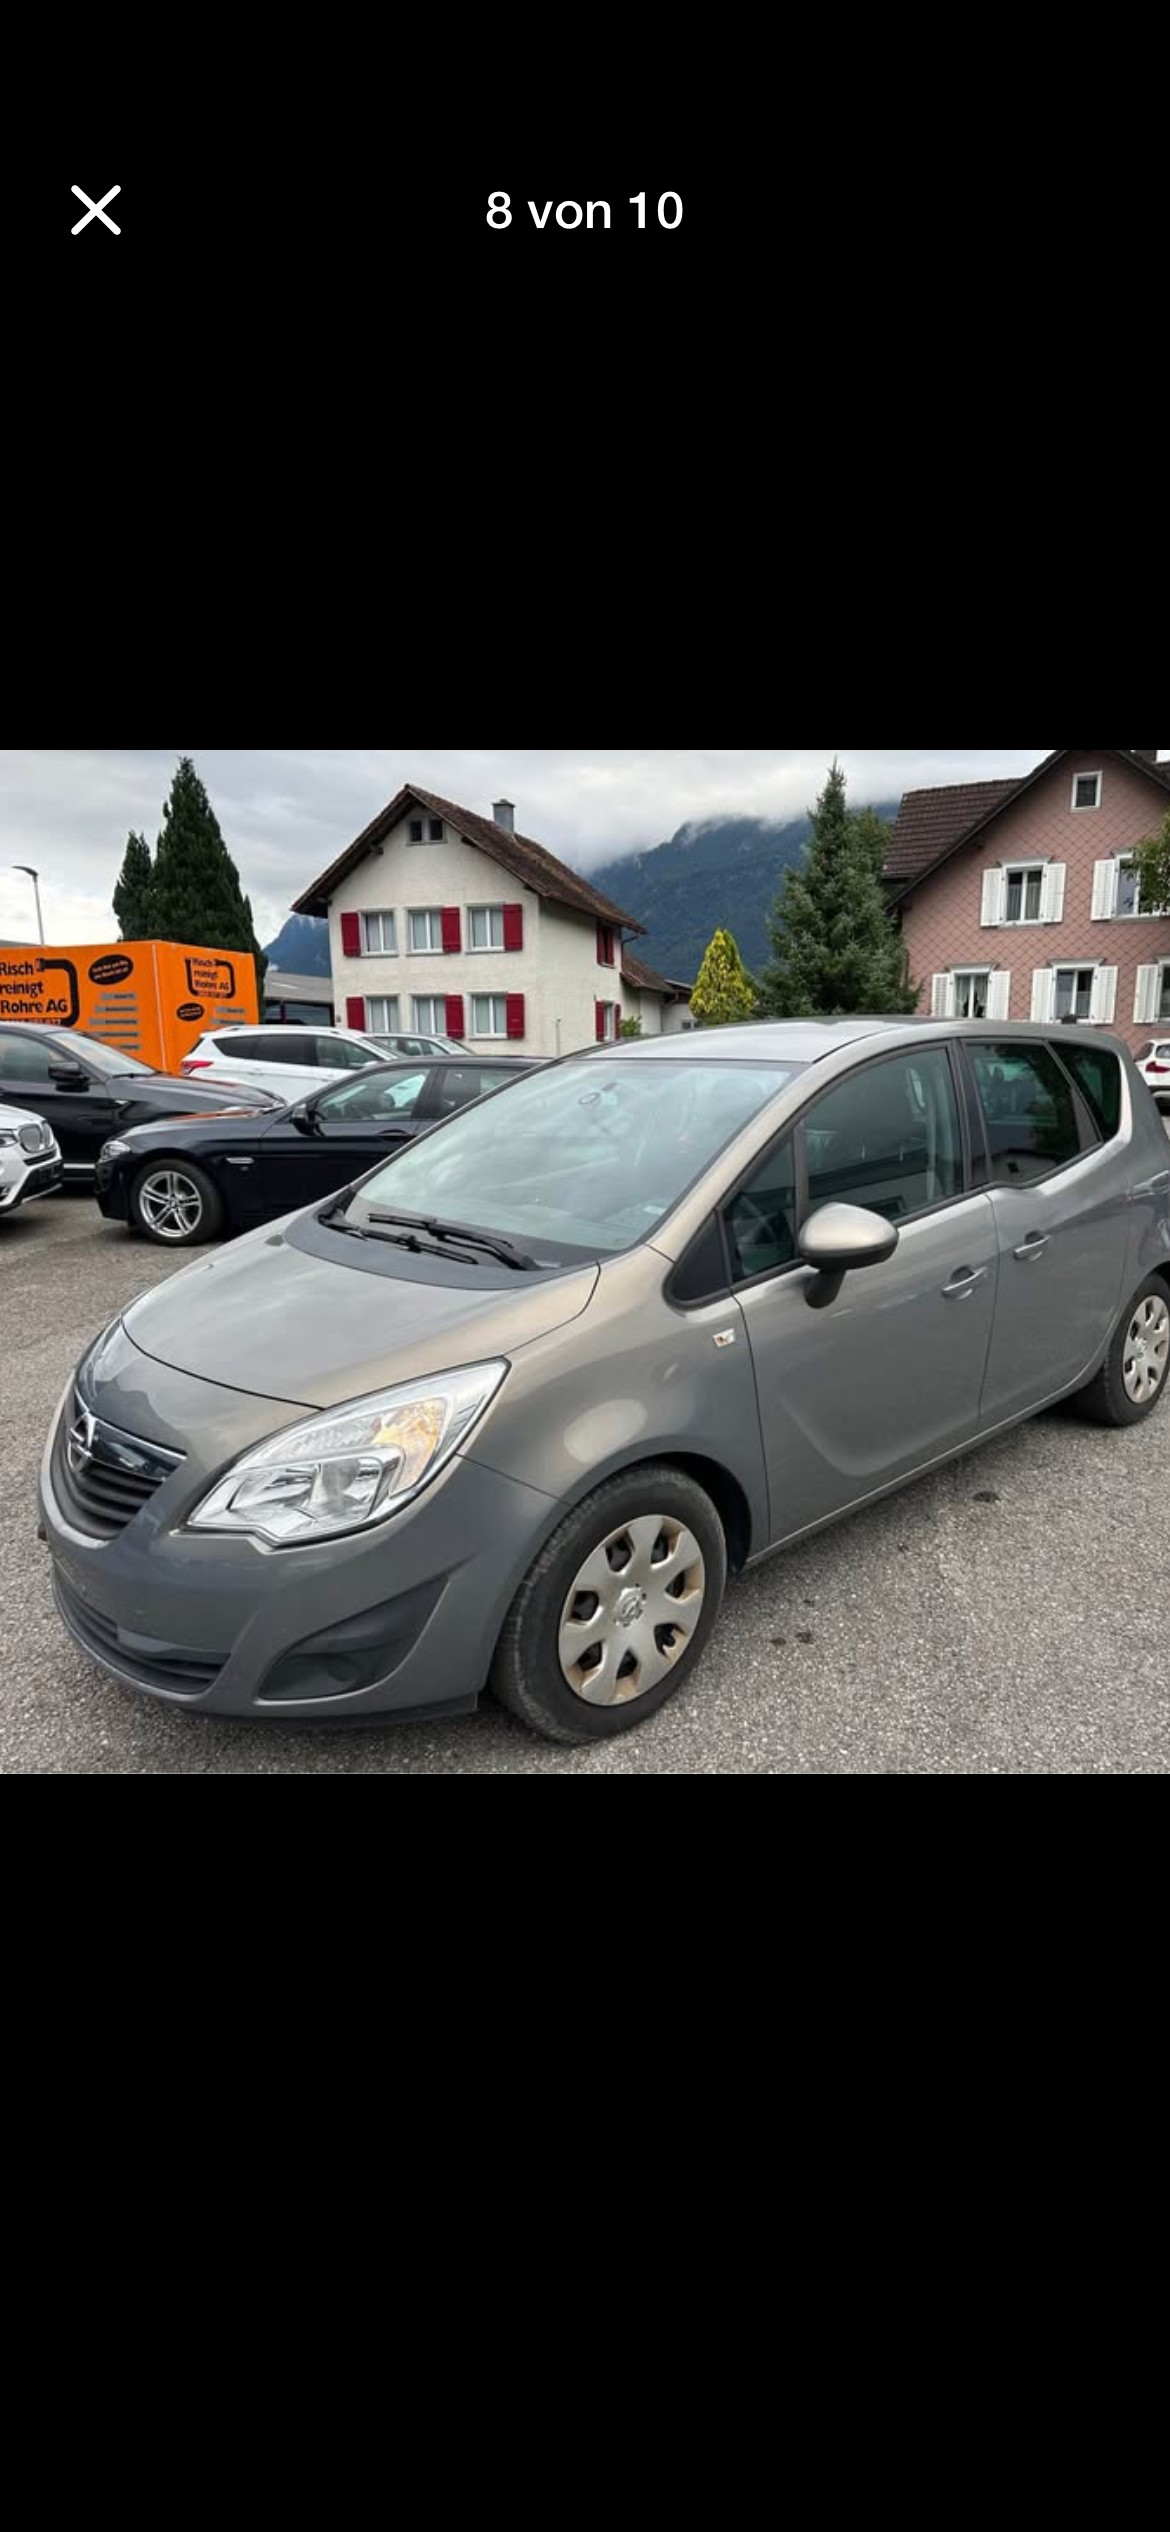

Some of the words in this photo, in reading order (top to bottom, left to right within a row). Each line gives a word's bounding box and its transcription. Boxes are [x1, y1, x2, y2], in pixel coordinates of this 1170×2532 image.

[0, 961, 34, 976] Risch
[0, 981, 44, 998] reinigt
[0, 1000, 43, 1013] Rohre
[46, 999, 67, 1013] AG
